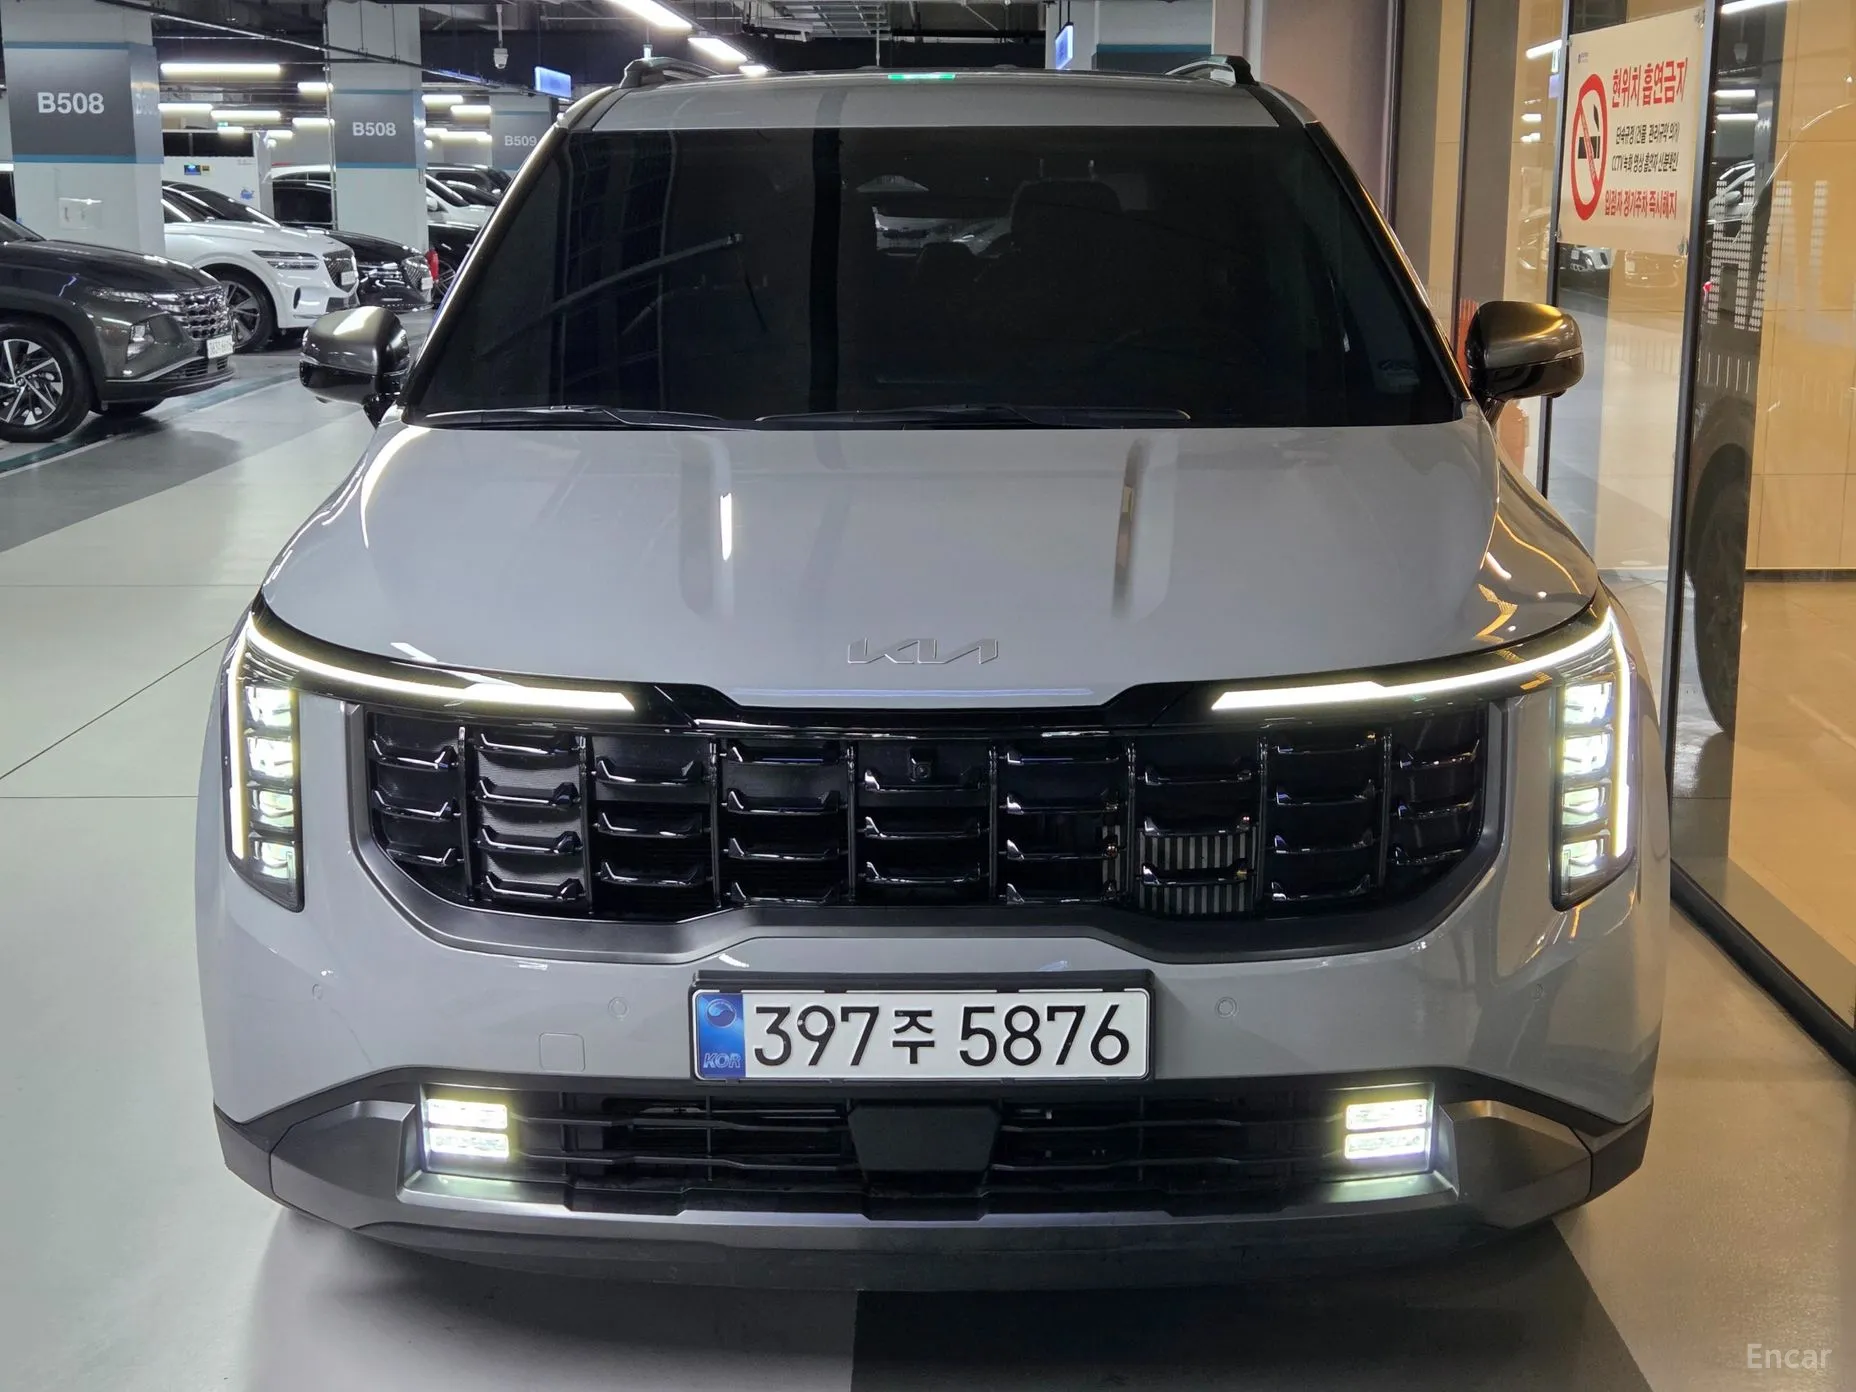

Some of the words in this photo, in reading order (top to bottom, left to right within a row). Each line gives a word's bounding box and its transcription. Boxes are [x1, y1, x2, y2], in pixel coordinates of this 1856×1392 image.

[1612, 65, 1642, 108] 현위치
[1642, 57, 1688, 106] 흡연금지
[37, 92, 105, 114] B508
[352, 121, 397, 137] B508
[504, 135, 538, 147] B509
[847, 637, 999, 665] KIA
[958, 1004, 1131, 1067] 5876
[703, 1052, 742, 1069] KOR
